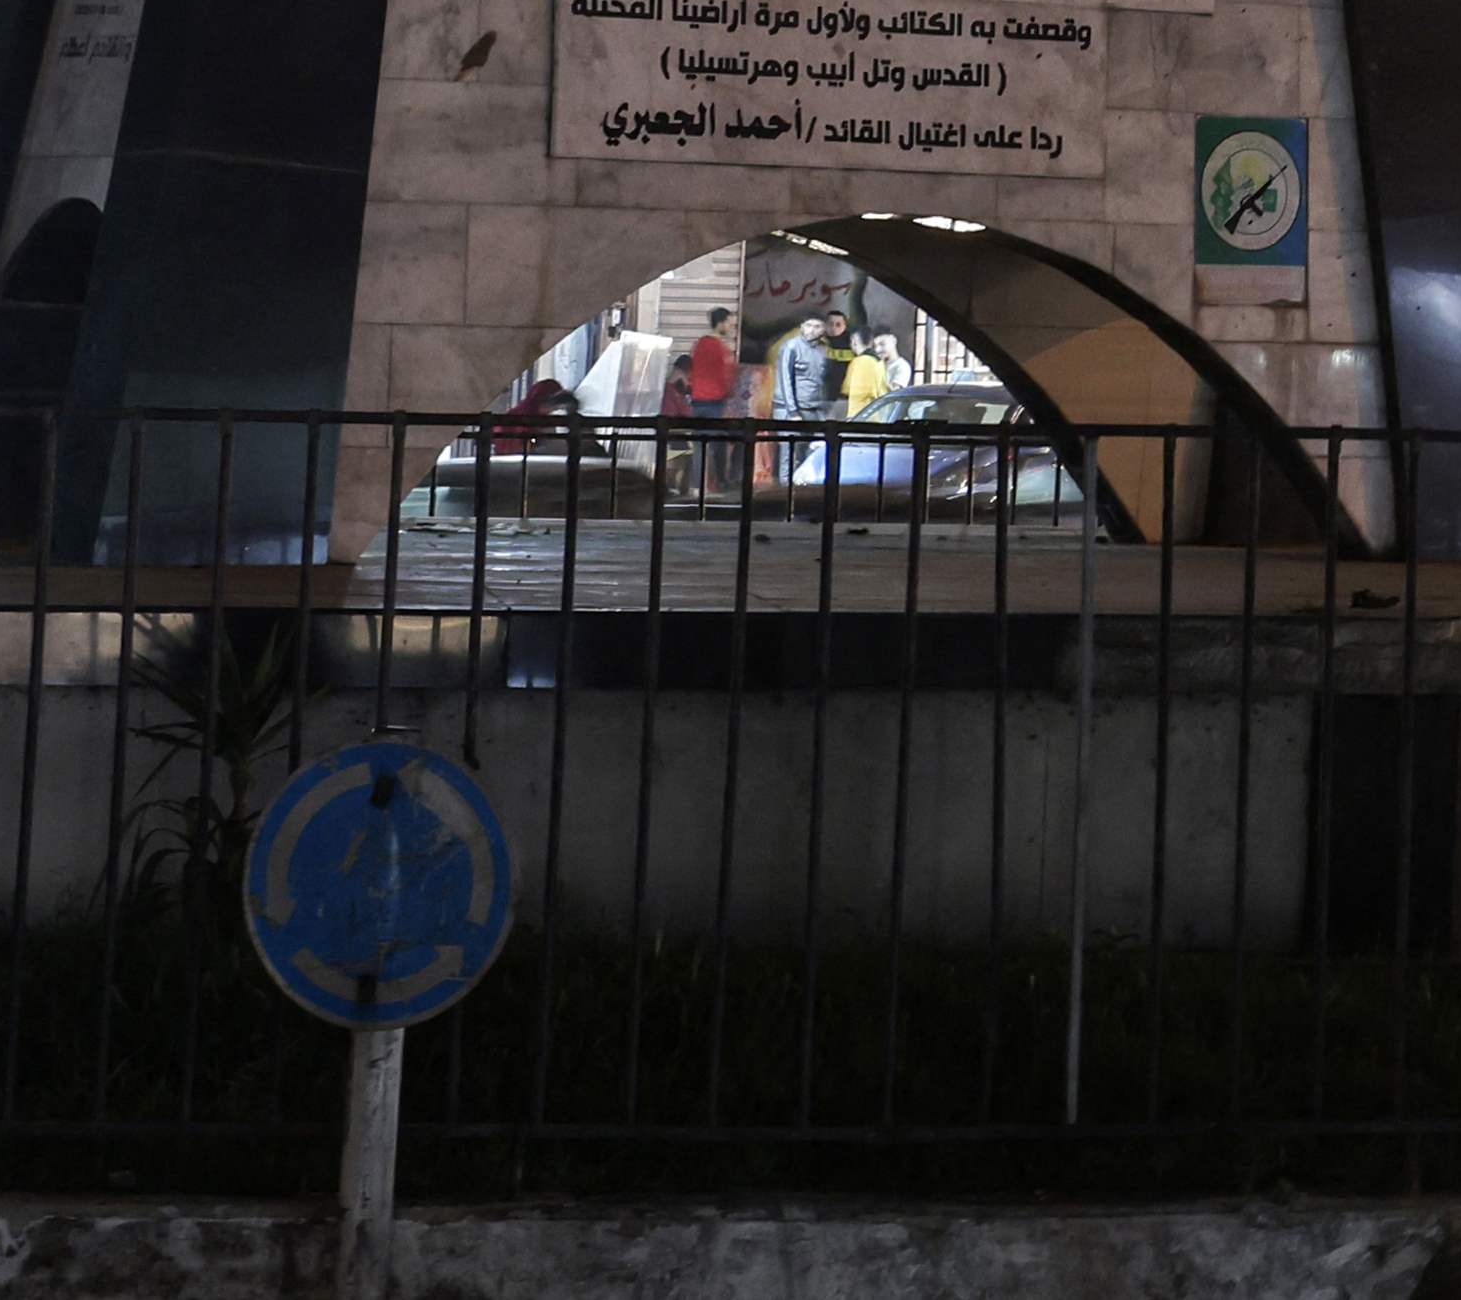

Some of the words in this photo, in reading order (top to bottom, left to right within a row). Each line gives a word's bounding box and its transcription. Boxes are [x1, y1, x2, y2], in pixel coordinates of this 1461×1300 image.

[755, 3, 799, 34] مرة
[807, 1, 870, 40] ولأول
[878, 10, 962, 40] الكتائب
[971, 20, 995, 44] به
[1003, 17, 1091, 49] وقصفت
[679, 49, 798, 85] وهرتسيليا
[807, 51, 854, 87] أبيب
[863, 58, 905, 91] وتل
[913, 64, 989, 90] القدس
[601, 102, 714, 146] الجعبري
[824, 119, 890, 144] القائد
[899, 121, 965, 152] اغتيال
[974, 125, 1022, 148] على
[1030, 126, 1063, 159] ردا
